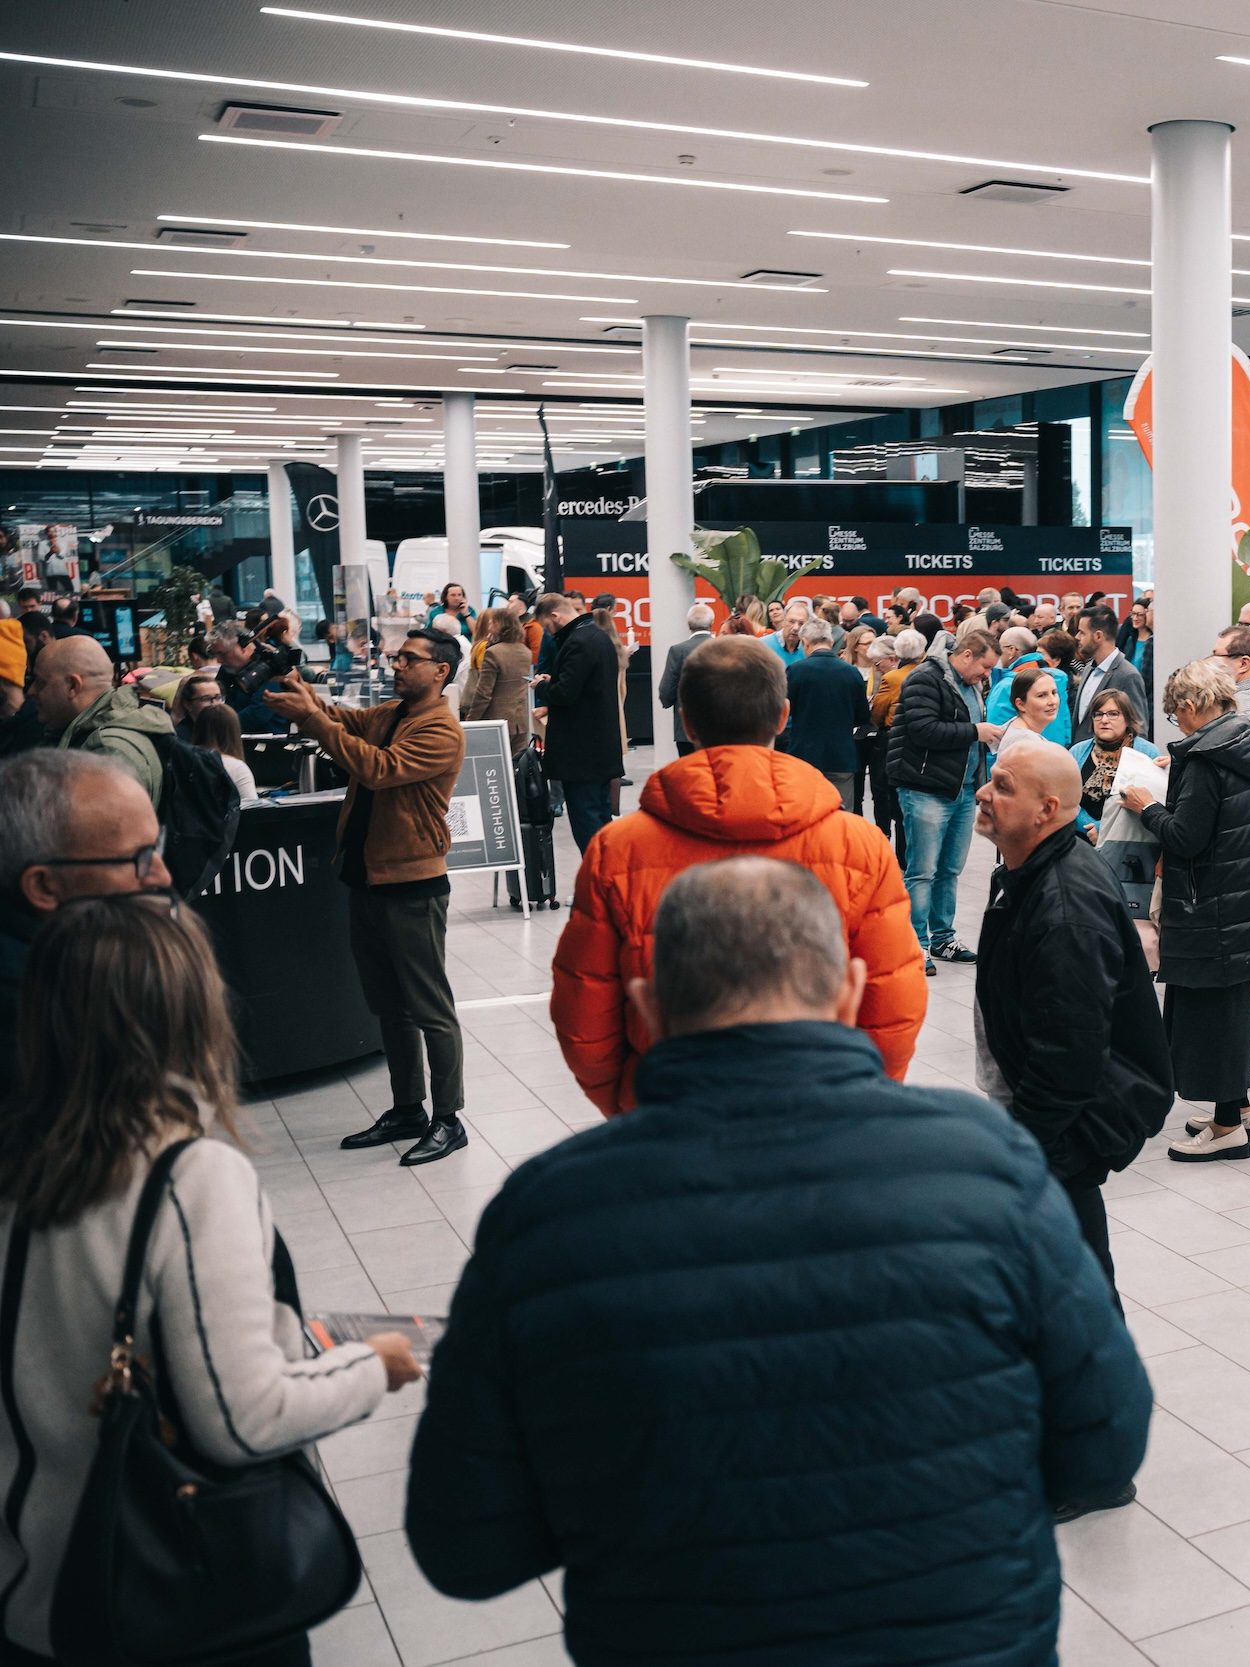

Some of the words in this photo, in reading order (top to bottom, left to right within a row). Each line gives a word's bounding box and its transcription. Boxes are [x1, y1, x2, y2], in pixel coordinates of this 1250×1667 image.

[557, 497, 641, 516] ercedes-B
[597, 553, 650, 572] TICK
[905, 554, 973, 569] TICKETS
[1038, 557, 1102, 571] TICKETS
[486, 768, 506, 850] HIGHLIGHTS
[200, 844, 304, 896] ION
